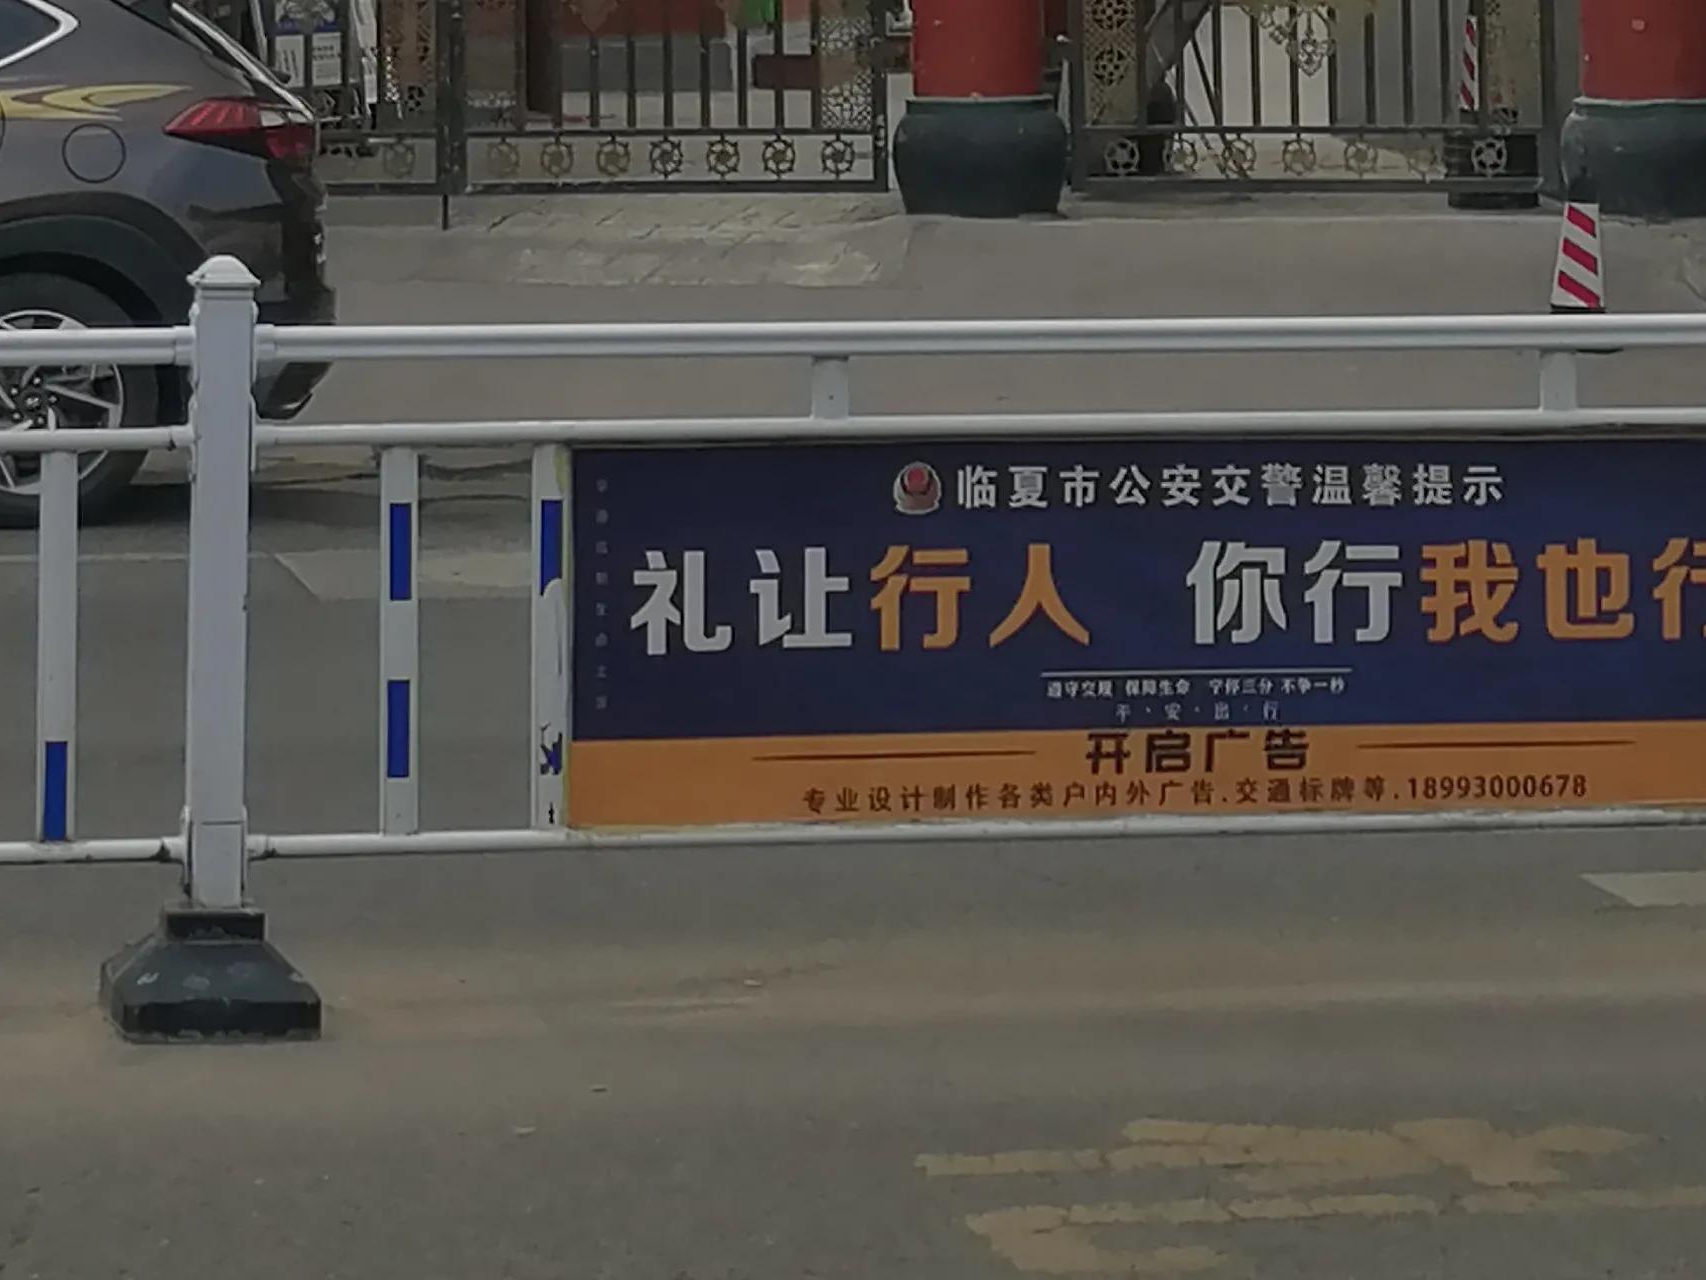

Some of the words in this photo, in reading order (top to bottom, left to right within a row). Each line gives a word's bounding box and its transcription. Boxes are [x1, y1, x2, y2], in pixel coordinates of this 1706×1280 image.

[955, 462, 1506, 509] 临夏市公安交警温馨提示
[630, 542, 1091, 657] 礼让行人
[1085, 728, 1310, 776] 开启广告
